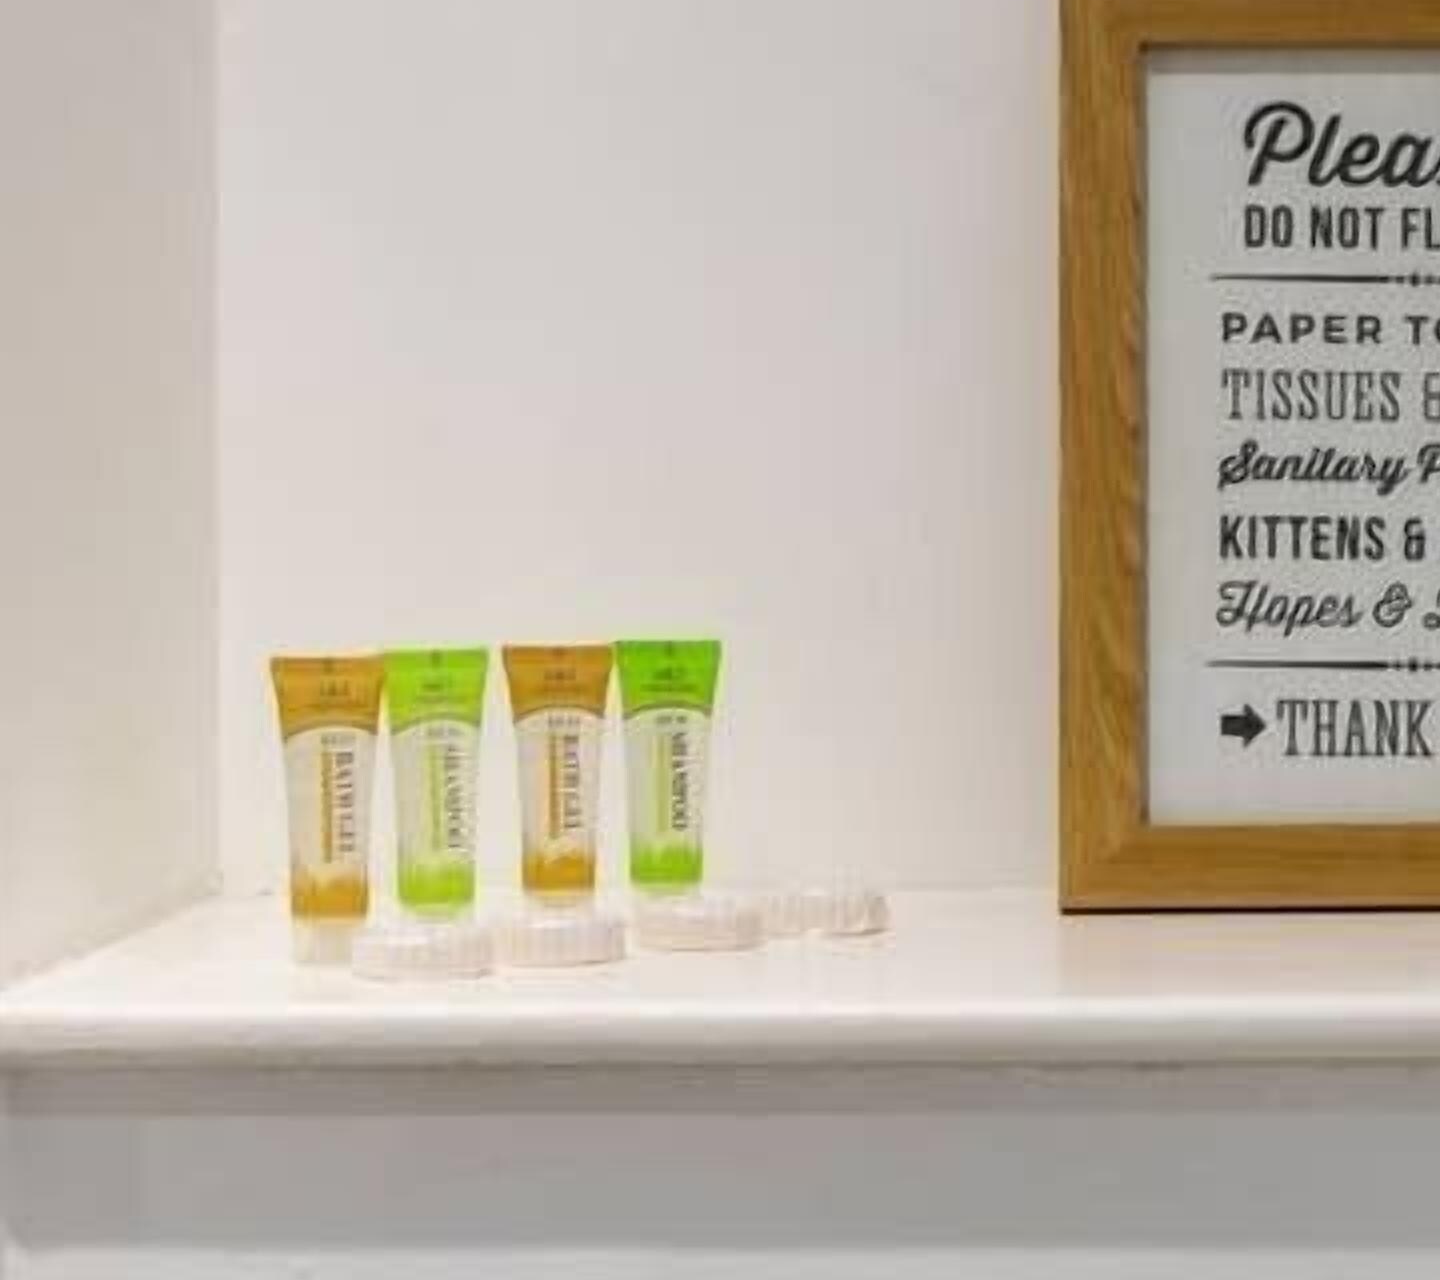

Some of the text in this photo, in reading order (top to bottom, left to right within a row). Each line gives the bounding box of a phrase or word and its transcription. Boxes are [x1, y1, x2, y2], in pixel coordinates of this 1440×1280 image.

[1243, 204, 1295, 249] DO
[1310, 204, 1387, 251] NOT
[1221, 312, 1382, 345] PAPER
[1222, 368, 1402, 423] TISSUES
[1218, 440, 1411, 496] Sanitary
[1220, 515, 1387, 563] KITTENS
[1402, 517, 1427, 562] &
[1215, 579, 1364, 638] Hopes
[1373, 582, 1414, 632] &
[1277, 698, 1436, 759] THANK
